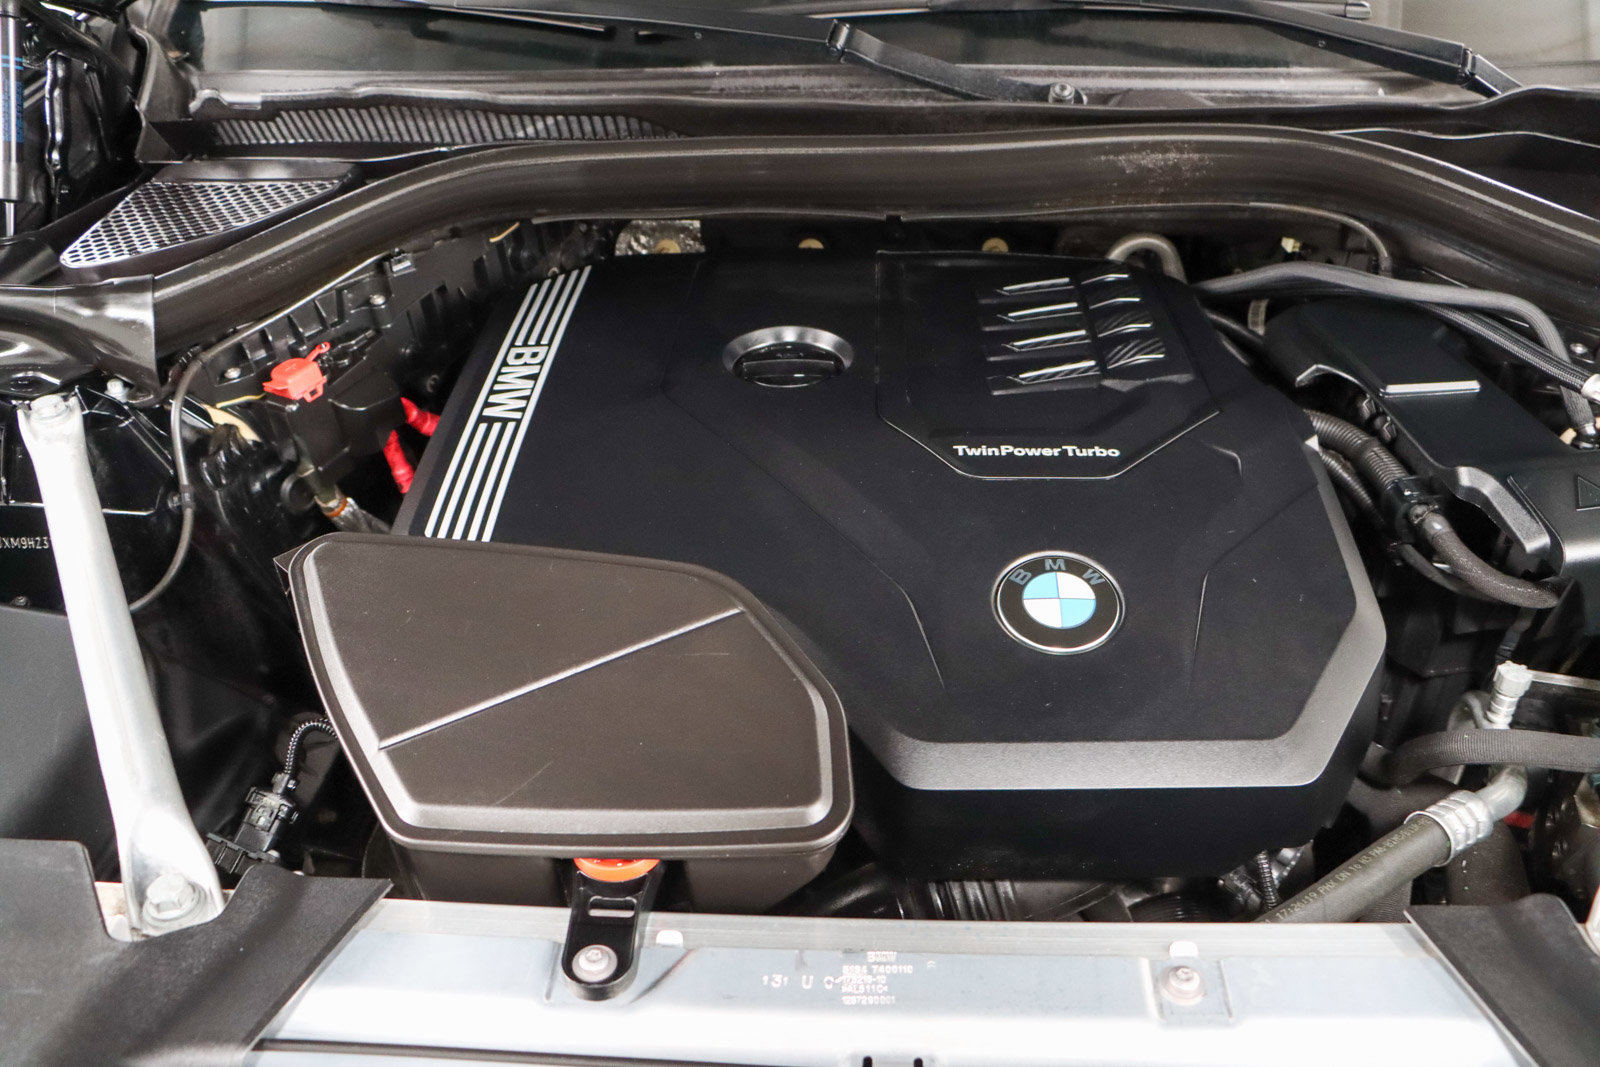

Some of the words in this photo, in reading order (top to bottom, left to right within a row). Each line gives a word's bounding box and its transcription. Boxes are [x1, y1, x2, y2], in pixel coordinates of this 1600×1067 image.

[482, 346, 549, 419] BMW
[1062, 445, 1121, 457] Turbo
[0, 536, 49, 550] XM9H23
[1008, 558, 1105, 586] BMW
